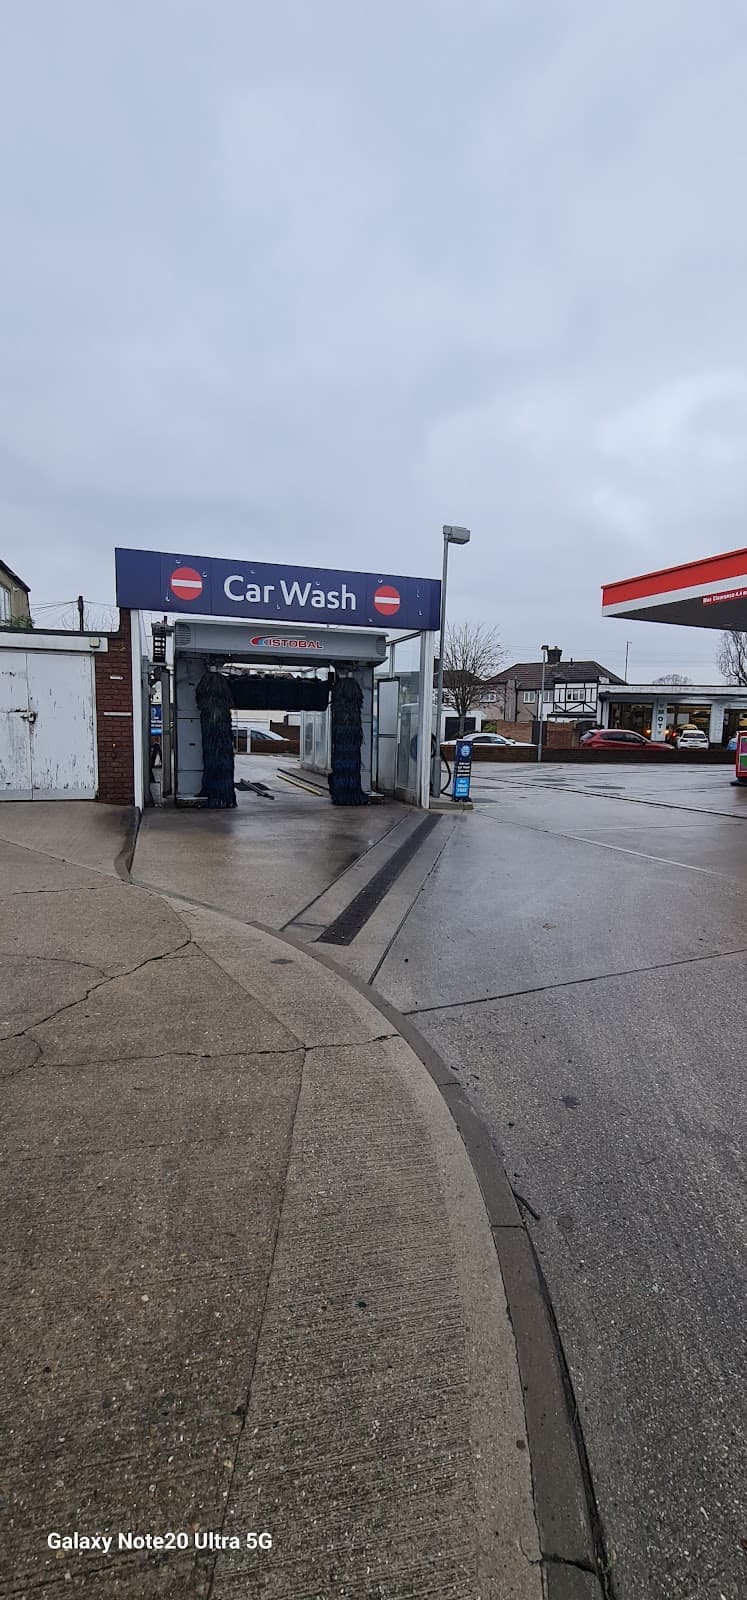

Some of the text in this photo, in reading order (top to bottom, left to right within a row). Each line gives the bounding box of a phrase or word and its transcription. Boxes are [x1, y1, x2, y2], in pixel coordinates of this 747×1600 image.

[223, 575, 356, 610] Car Wash
[269, 639, 324, 649] ISTOBAL
